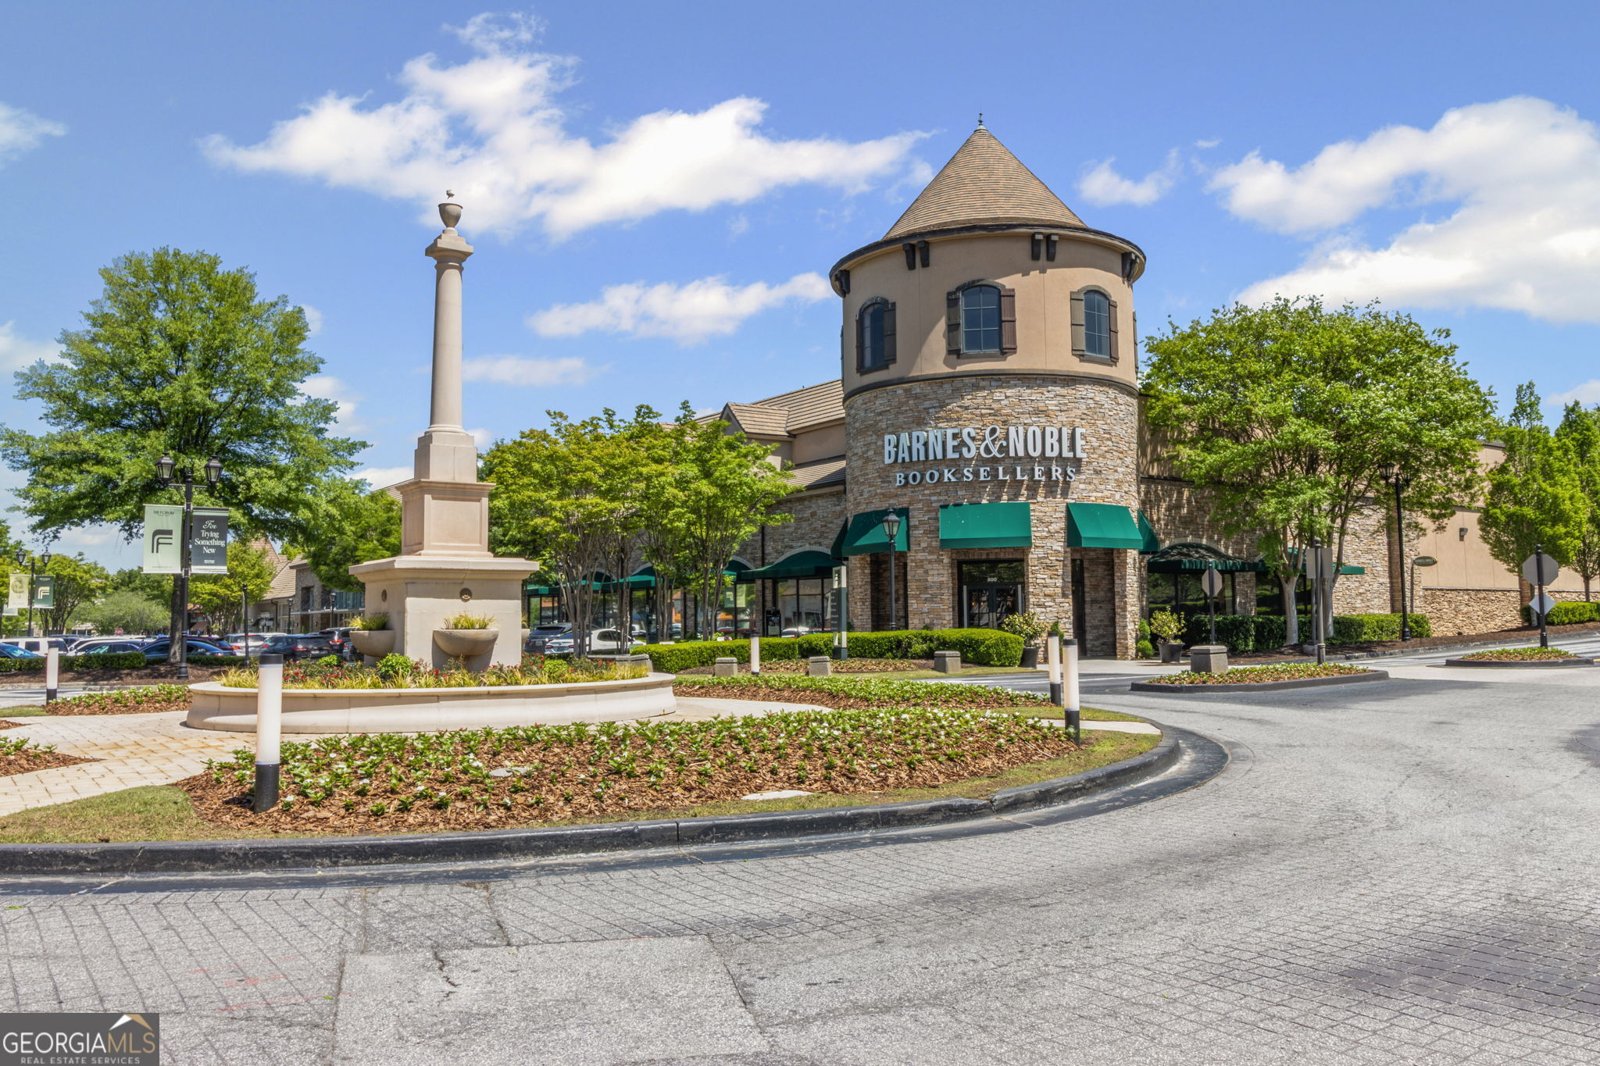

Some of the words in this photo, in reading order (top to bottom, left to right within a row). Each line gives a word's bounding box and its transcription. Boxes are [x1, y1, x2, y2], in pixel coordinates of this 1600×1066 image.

[896, 466, 1076, 487] BOOKSELLERS
[202, 520, 217, 529] For
[200, 530, 220, 539] Trying
[194, 538, 226, 548] Something
